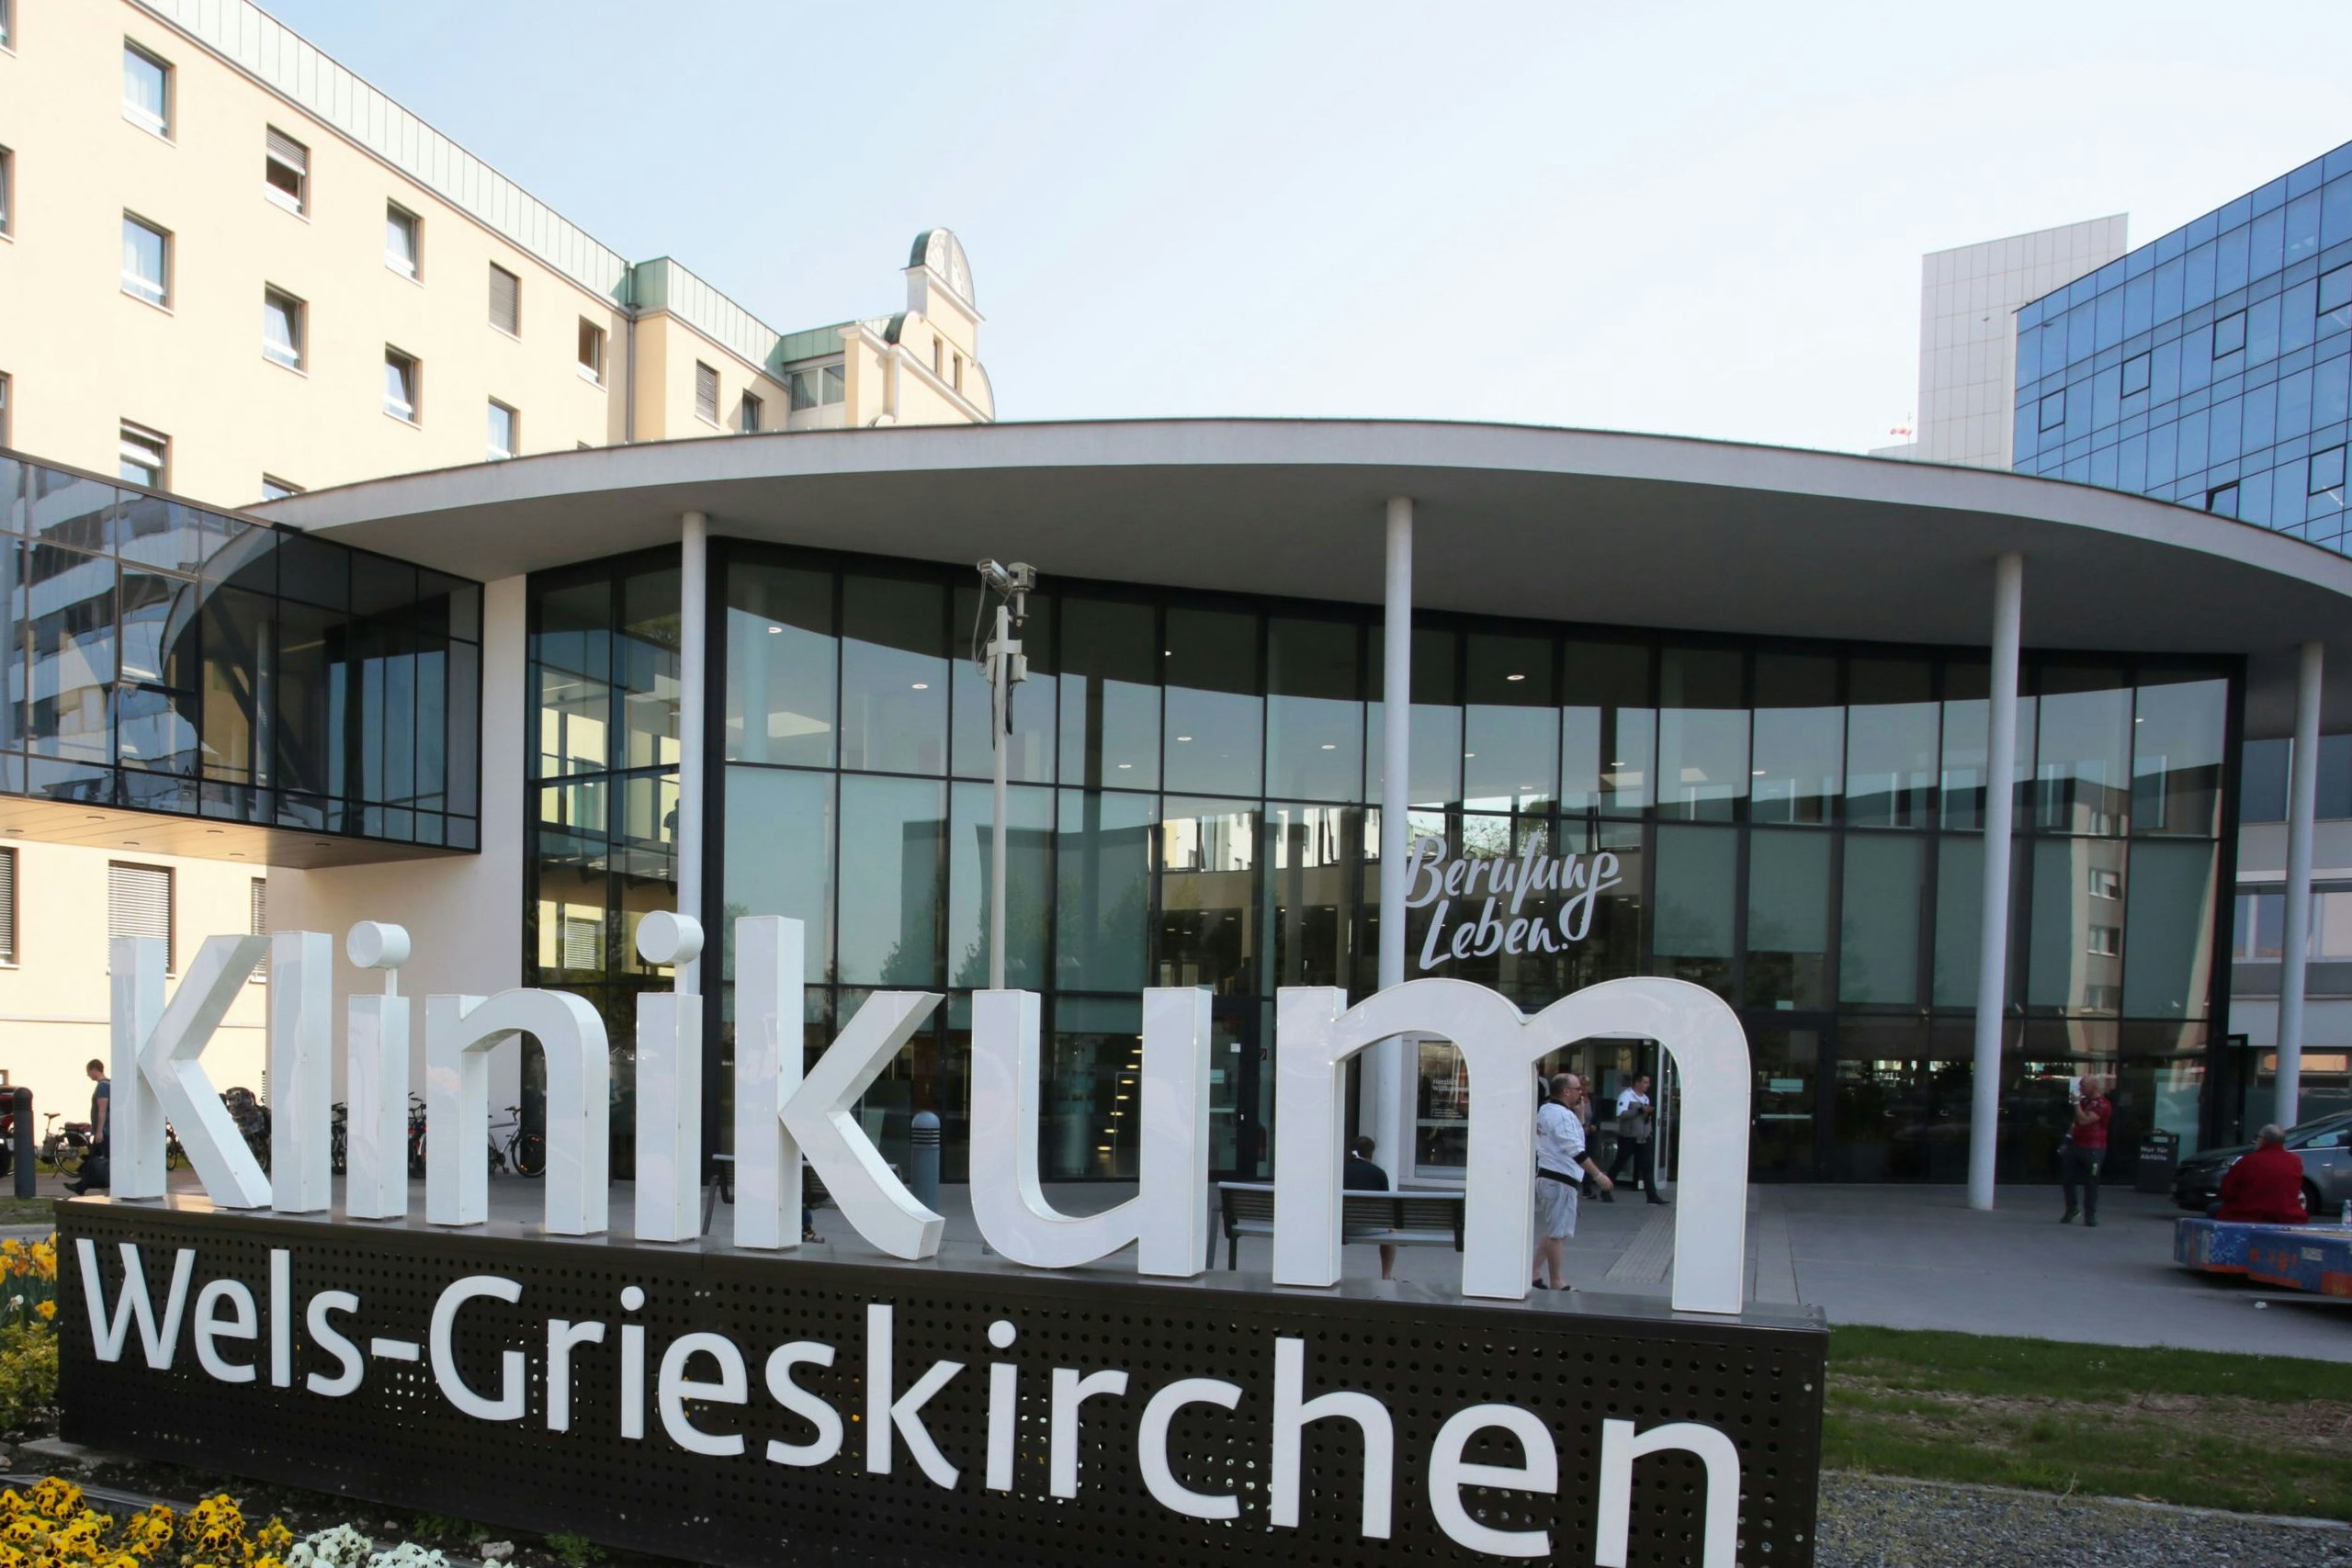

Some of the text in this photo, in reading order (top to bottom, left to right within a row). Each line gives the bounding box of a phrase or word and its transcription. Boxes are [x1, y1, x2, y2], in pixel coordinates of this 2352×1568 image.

[1405, 831, 1623, 942] Berufung
[1419, 897, 1569, 970] Leben.
[109, 910, 1751, 1314] Klinikum
[76, 1237, 1740, 1568] Wels-Grieskirchen
